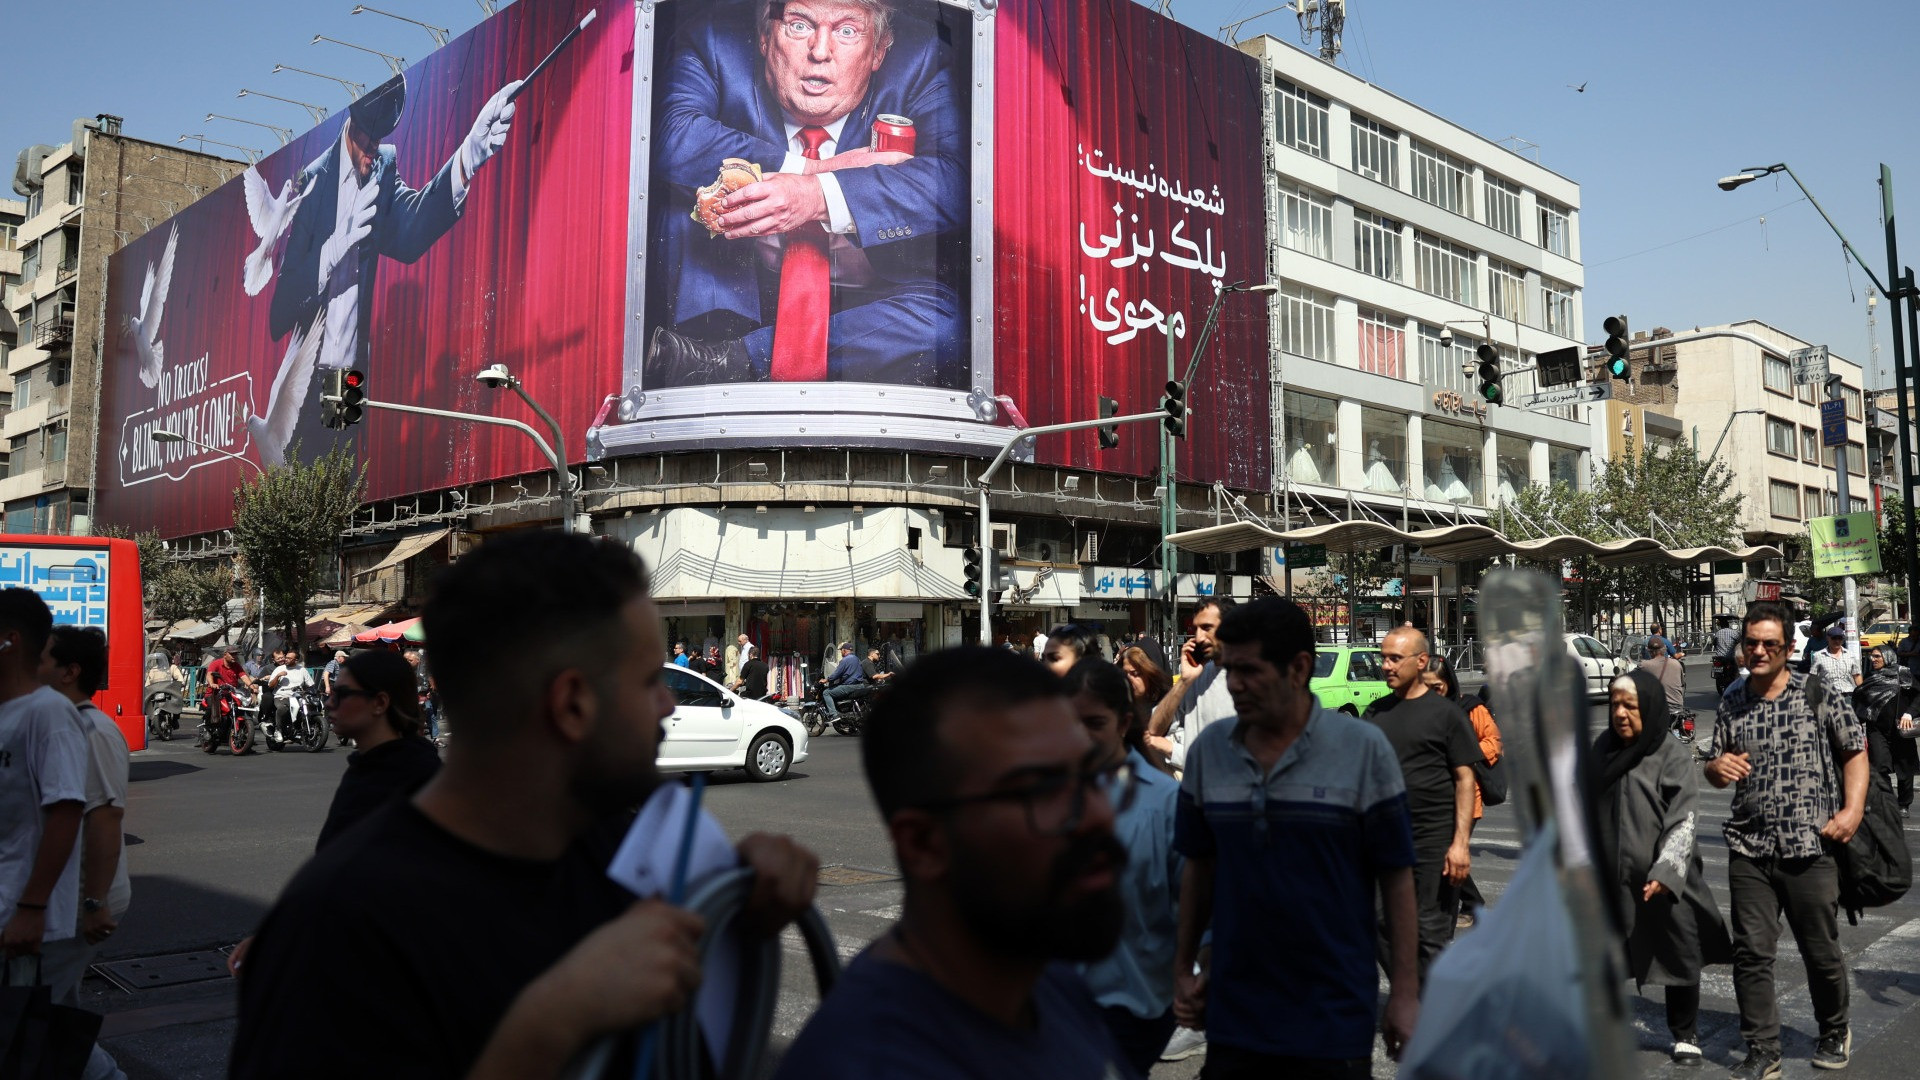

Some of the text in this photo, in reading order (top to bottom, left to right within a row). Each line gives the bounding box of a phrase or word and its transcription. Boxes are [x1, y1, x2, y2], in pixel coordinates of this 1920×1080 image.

[1159, 177, 1225, 215] شعبده
[1079, 201, 1227, 296] پلک بزنی
[157, 351, 209, 410] NO TRICKS!
[1550, 393, 1578, 404] جمهوری
[132, 391, 236, 474] BLINK, YOU'RE GONE!
[1094, 571, 1115, 594] نور
[1120, 572, 1152, 594] کوه
